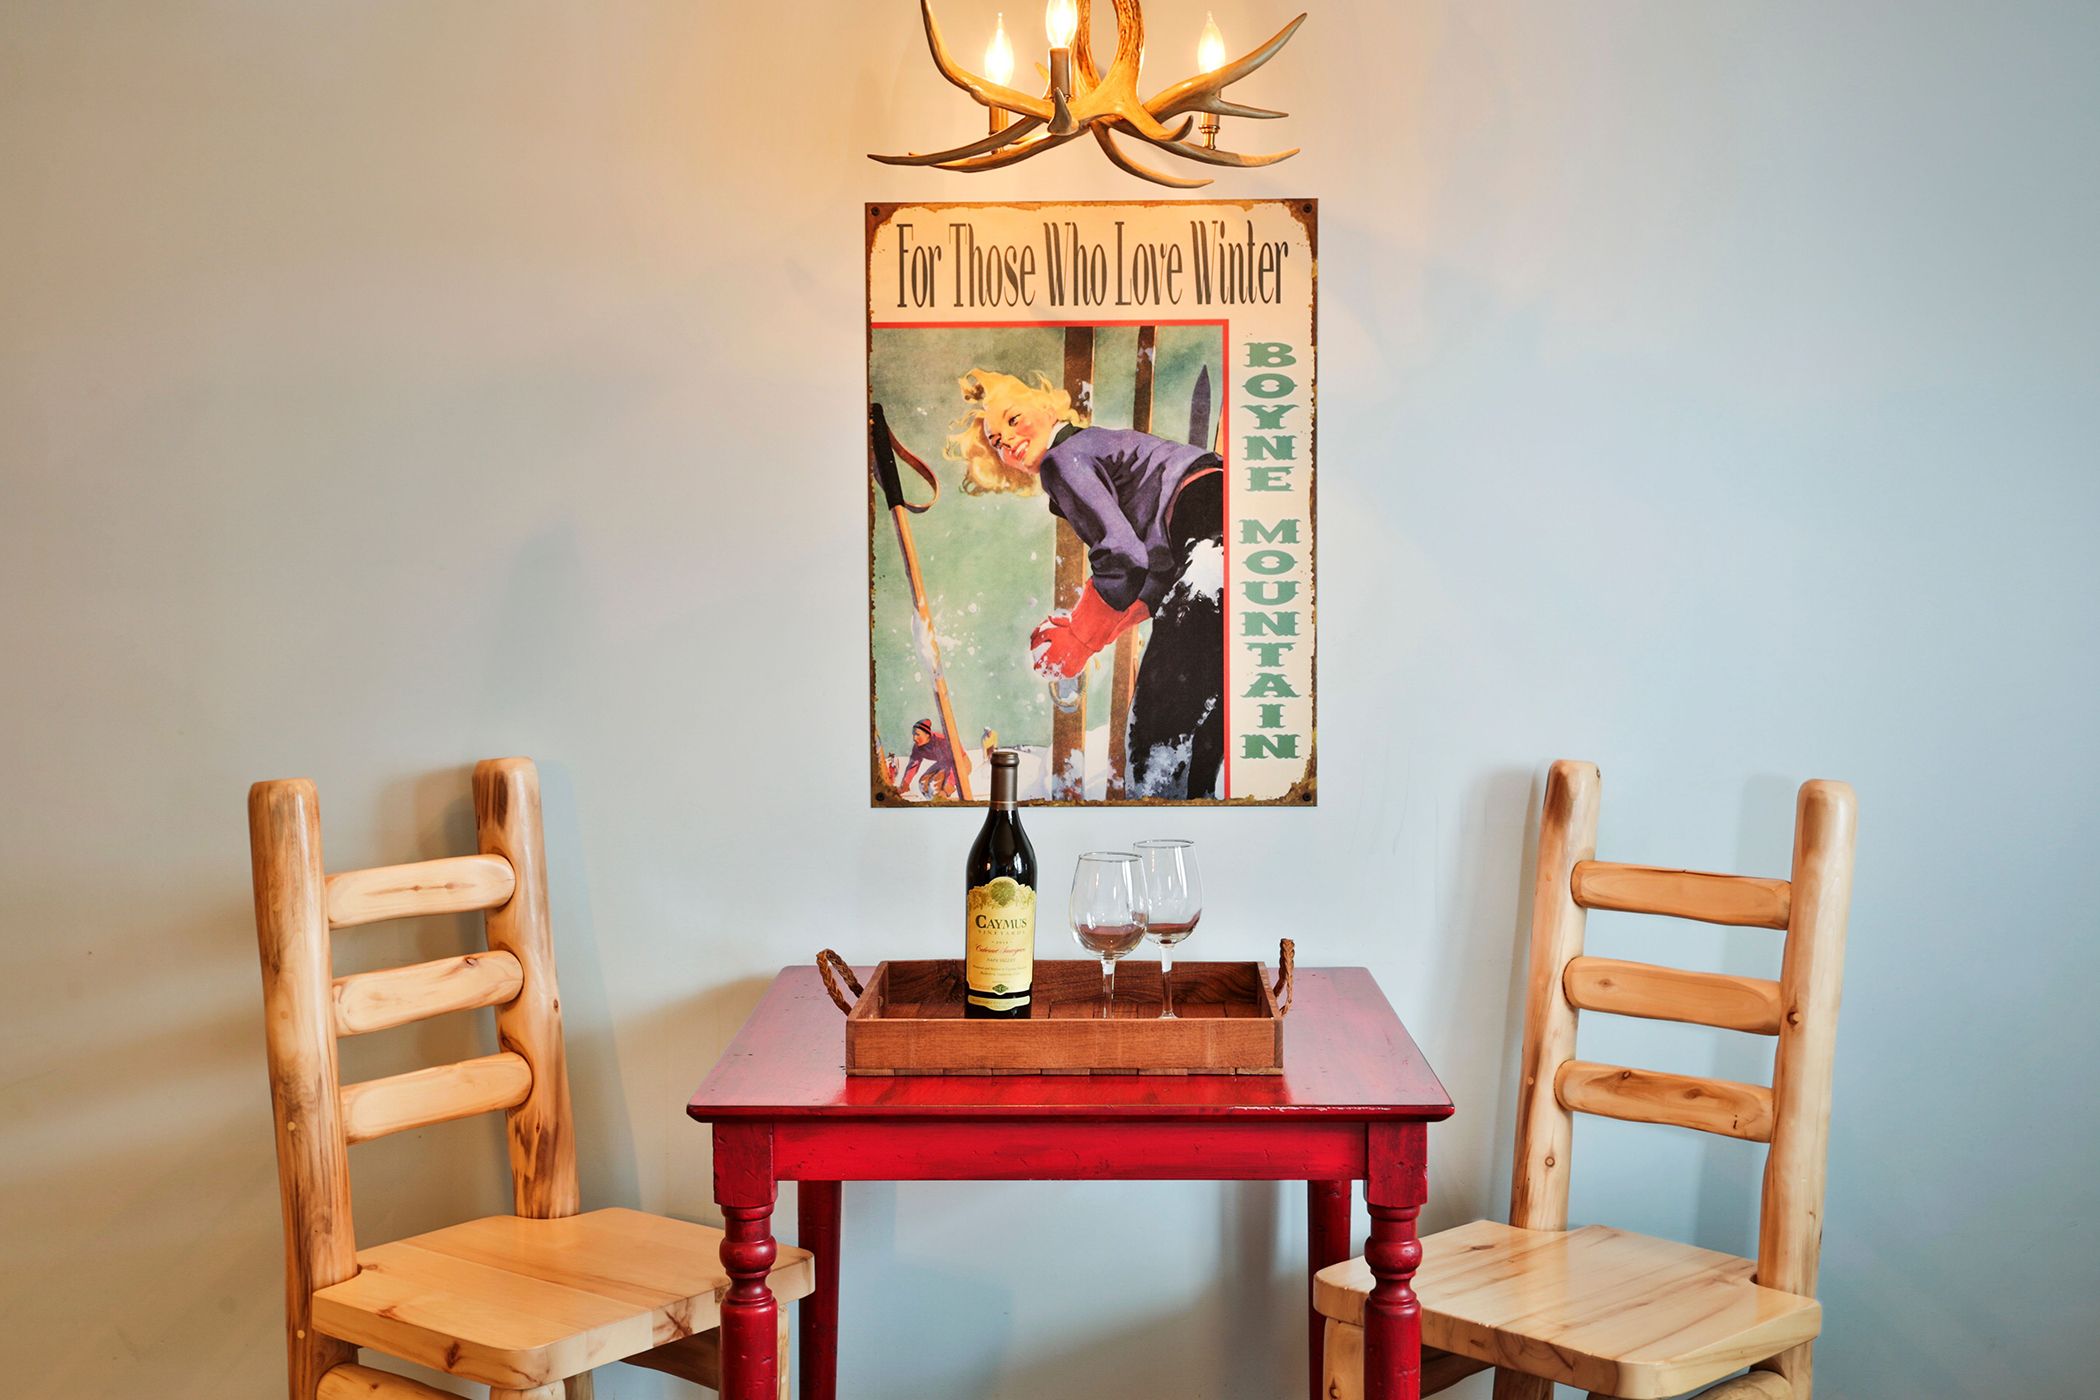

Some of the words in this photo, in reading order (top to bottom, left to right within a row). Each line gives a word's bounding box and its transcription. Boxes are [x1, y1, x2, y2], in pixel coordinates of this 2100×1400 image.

[896, 224, 941, 308] For
[949, 223, 1036, 307] Those
[1043, 222, 1107, 306] Who
[1115, 221, 1182, 305] Love
[1190, 220, 1288, 305] Winter
[1240, 342, 1299, 492] BOYNE
[1239, 518, 1301, 759] MOUNTAIN
